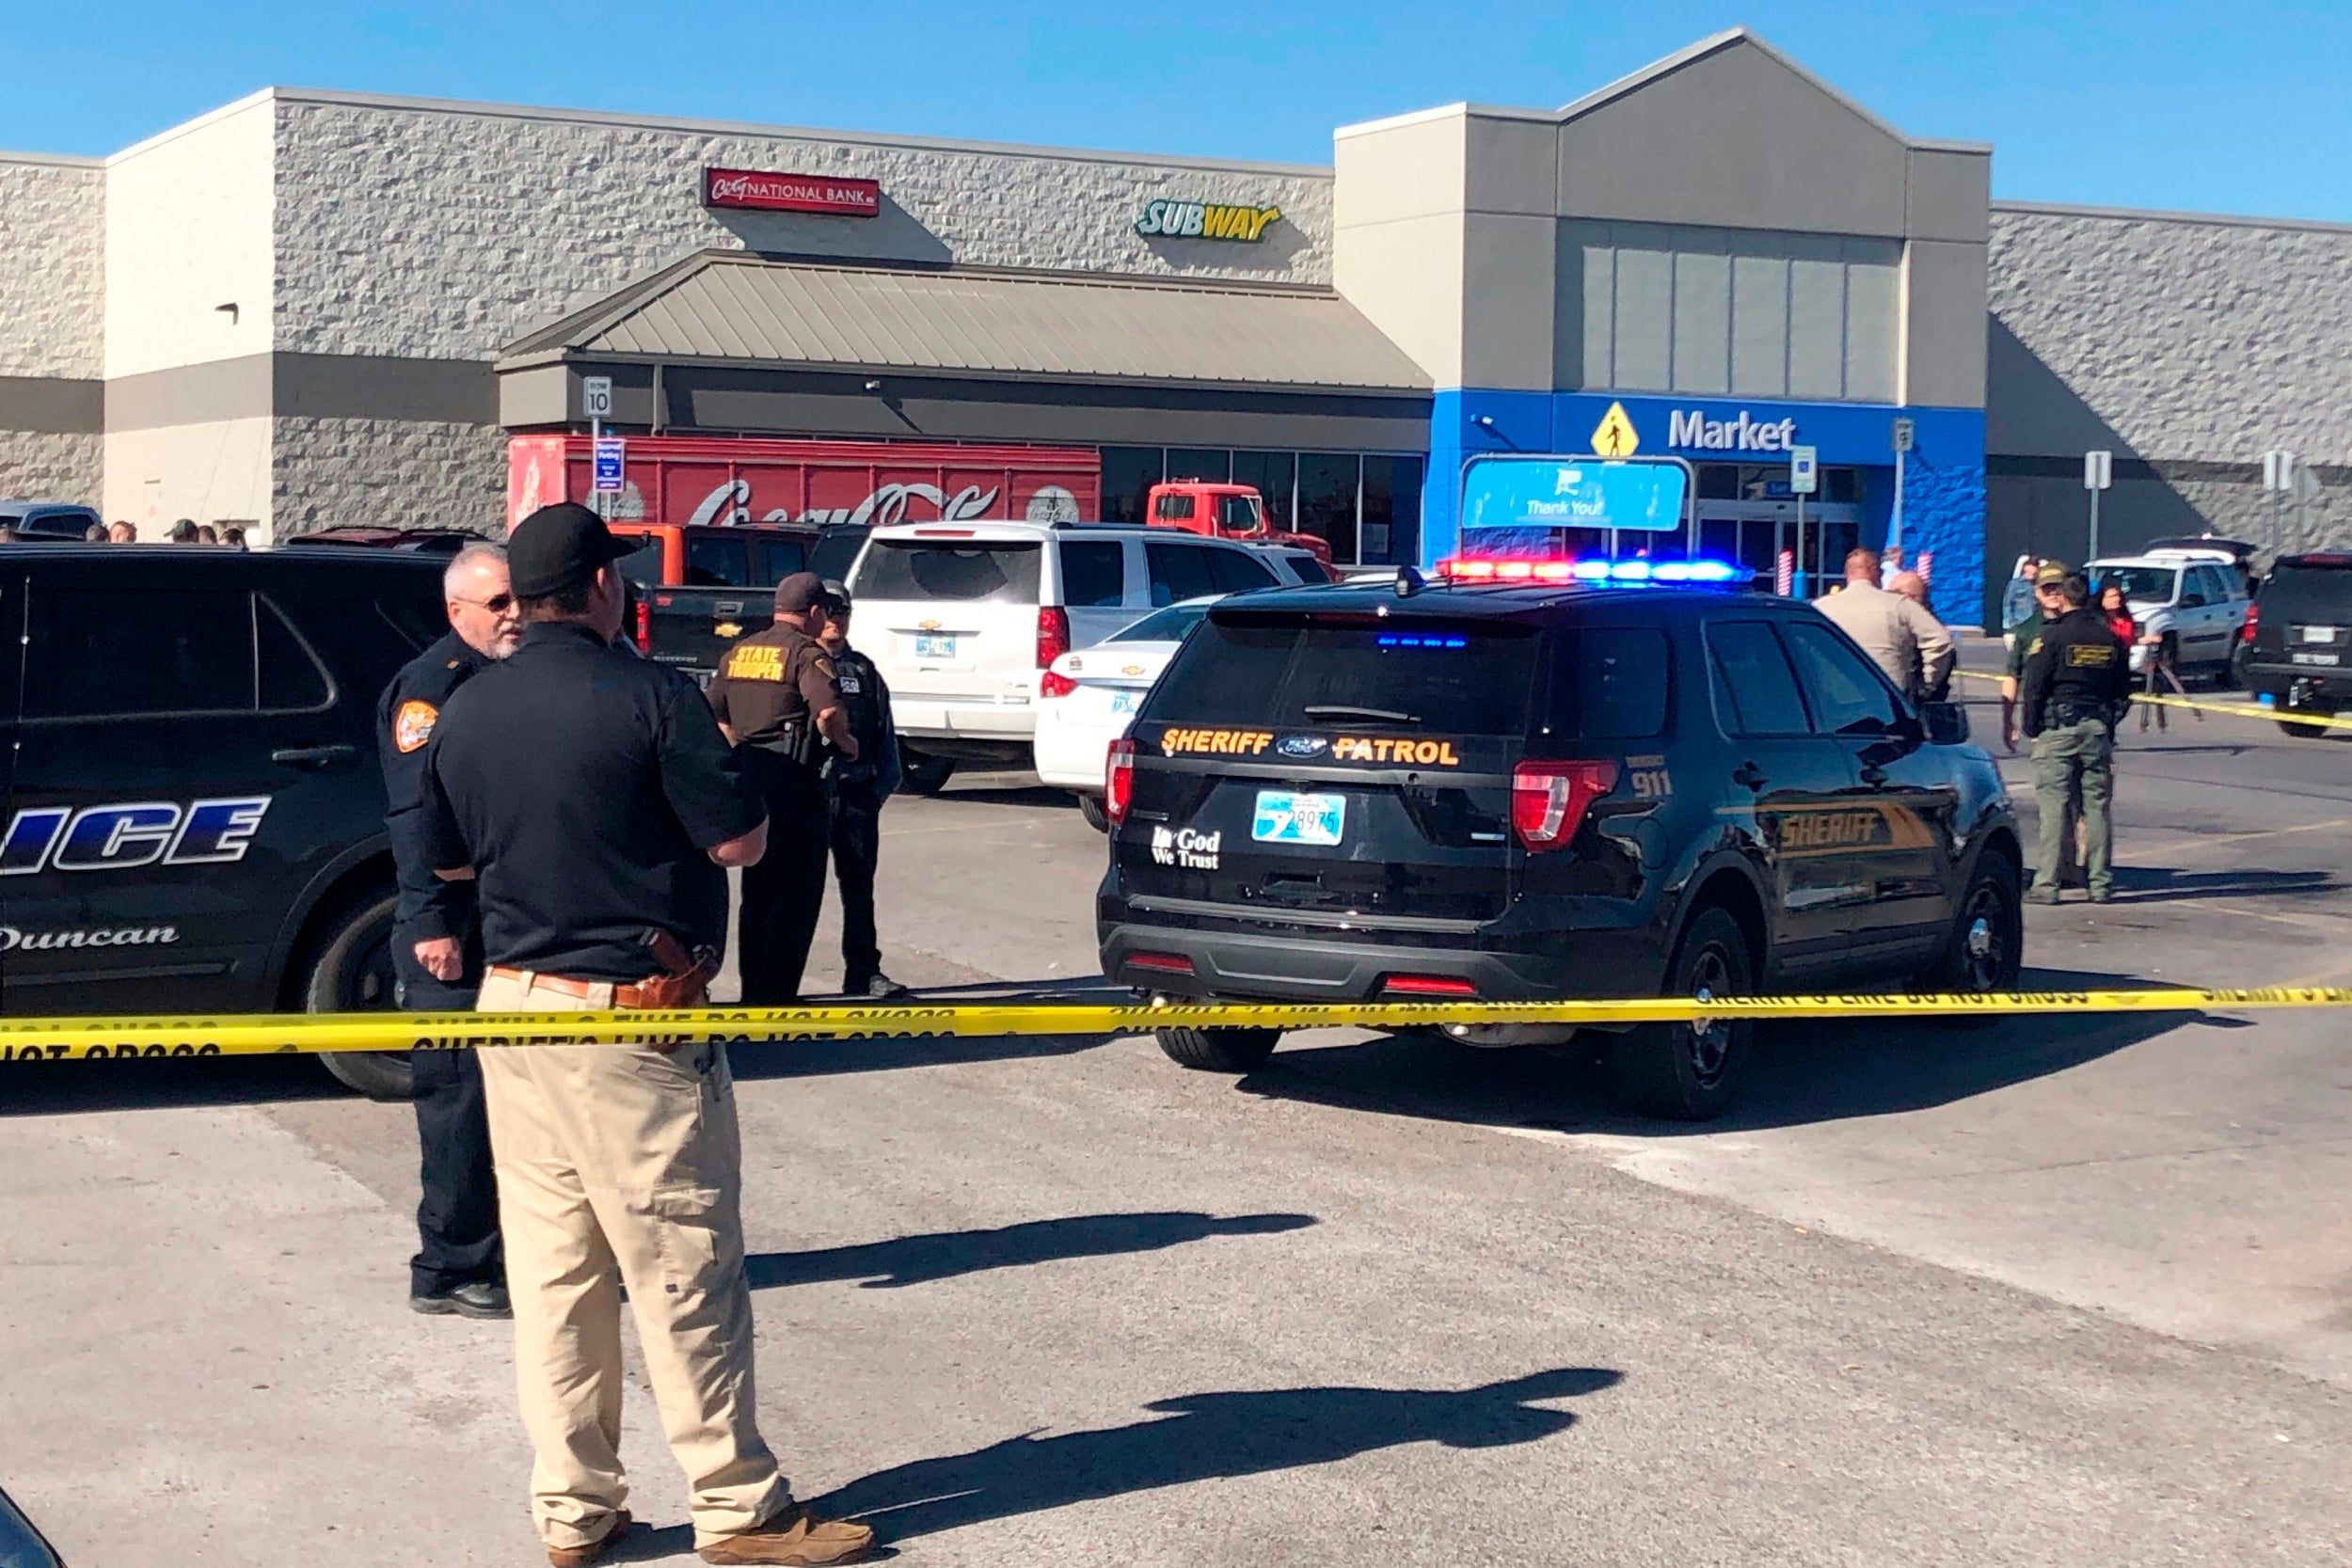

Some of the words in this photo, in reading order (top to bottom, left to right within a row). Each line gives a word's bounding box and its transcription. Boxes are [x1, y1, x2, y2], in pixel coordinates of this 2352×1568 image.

[711, 176, 749, 200] City
[748, 183, 823, 200] NATIONAL
[826, 187, 865, 203] BANK
[1137, 201, 1280, 241] SUBWAY
[590, 393, 608, 411] 10
[1668, 409, 1796, 451] Market
[1526, 499, 1569, 515] Thank
[735, 645, 781, 662] STATE
[727, 660, 783, 680] TROOPER
[1161, 729, 1274, 754] SHERIFF
[1334, 737, 1459, 766] PATROL
[1631, 769, 1673, 798] 911
[1177, 828, 1221, 852] God
[1780, 813, 1879, 847] SHERIFF
[1152, 847, 1174, 865] We
[1177, 849, 1218, 869] Trust
[0, 925, 181, 952] Duncan
